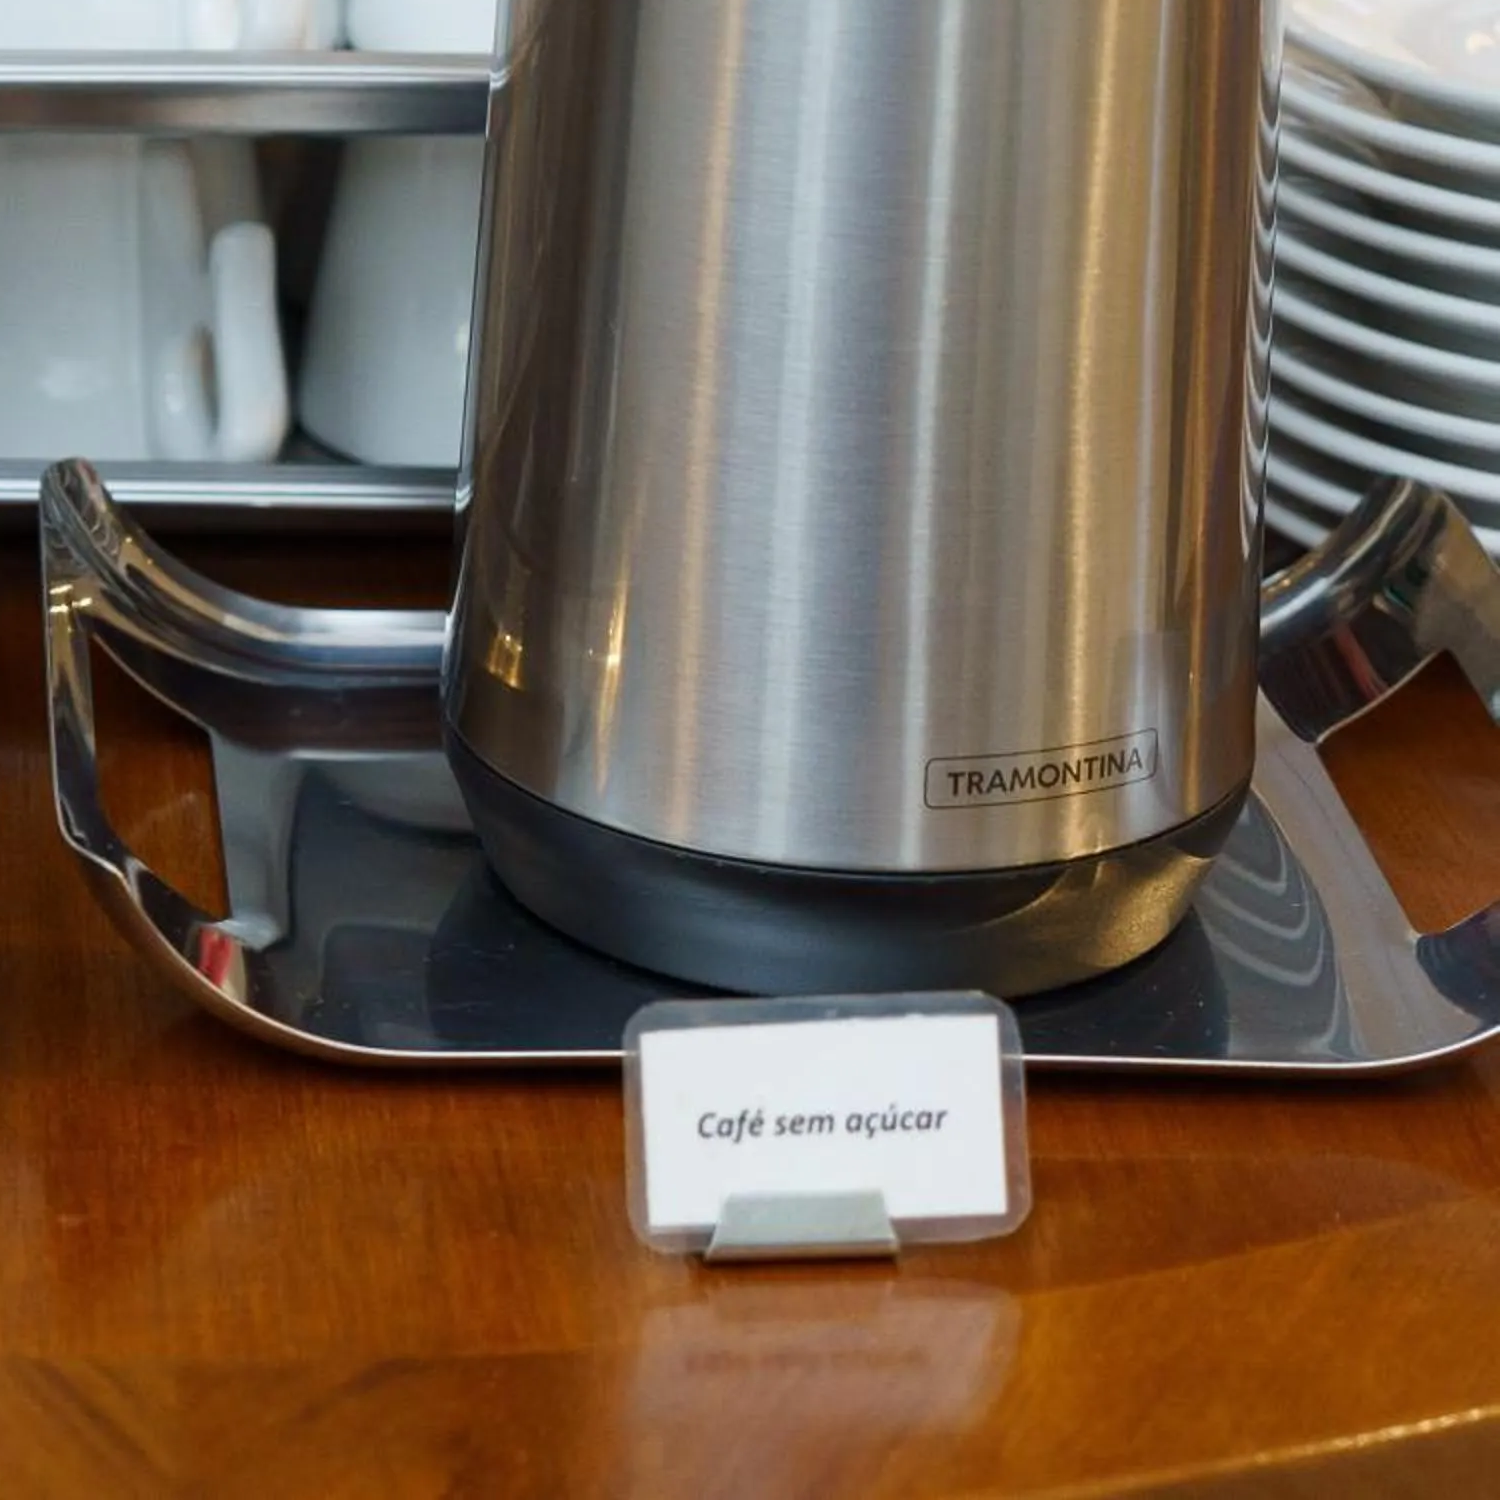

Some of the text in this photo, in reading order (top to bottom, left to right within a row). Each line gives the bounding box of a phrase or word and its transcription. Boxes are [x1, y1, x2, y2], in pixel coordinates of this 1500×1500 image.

[947, 748, 1143, 796] TRAMONTINA
[698, 1102, 948, 1144] Café sem açúcar
